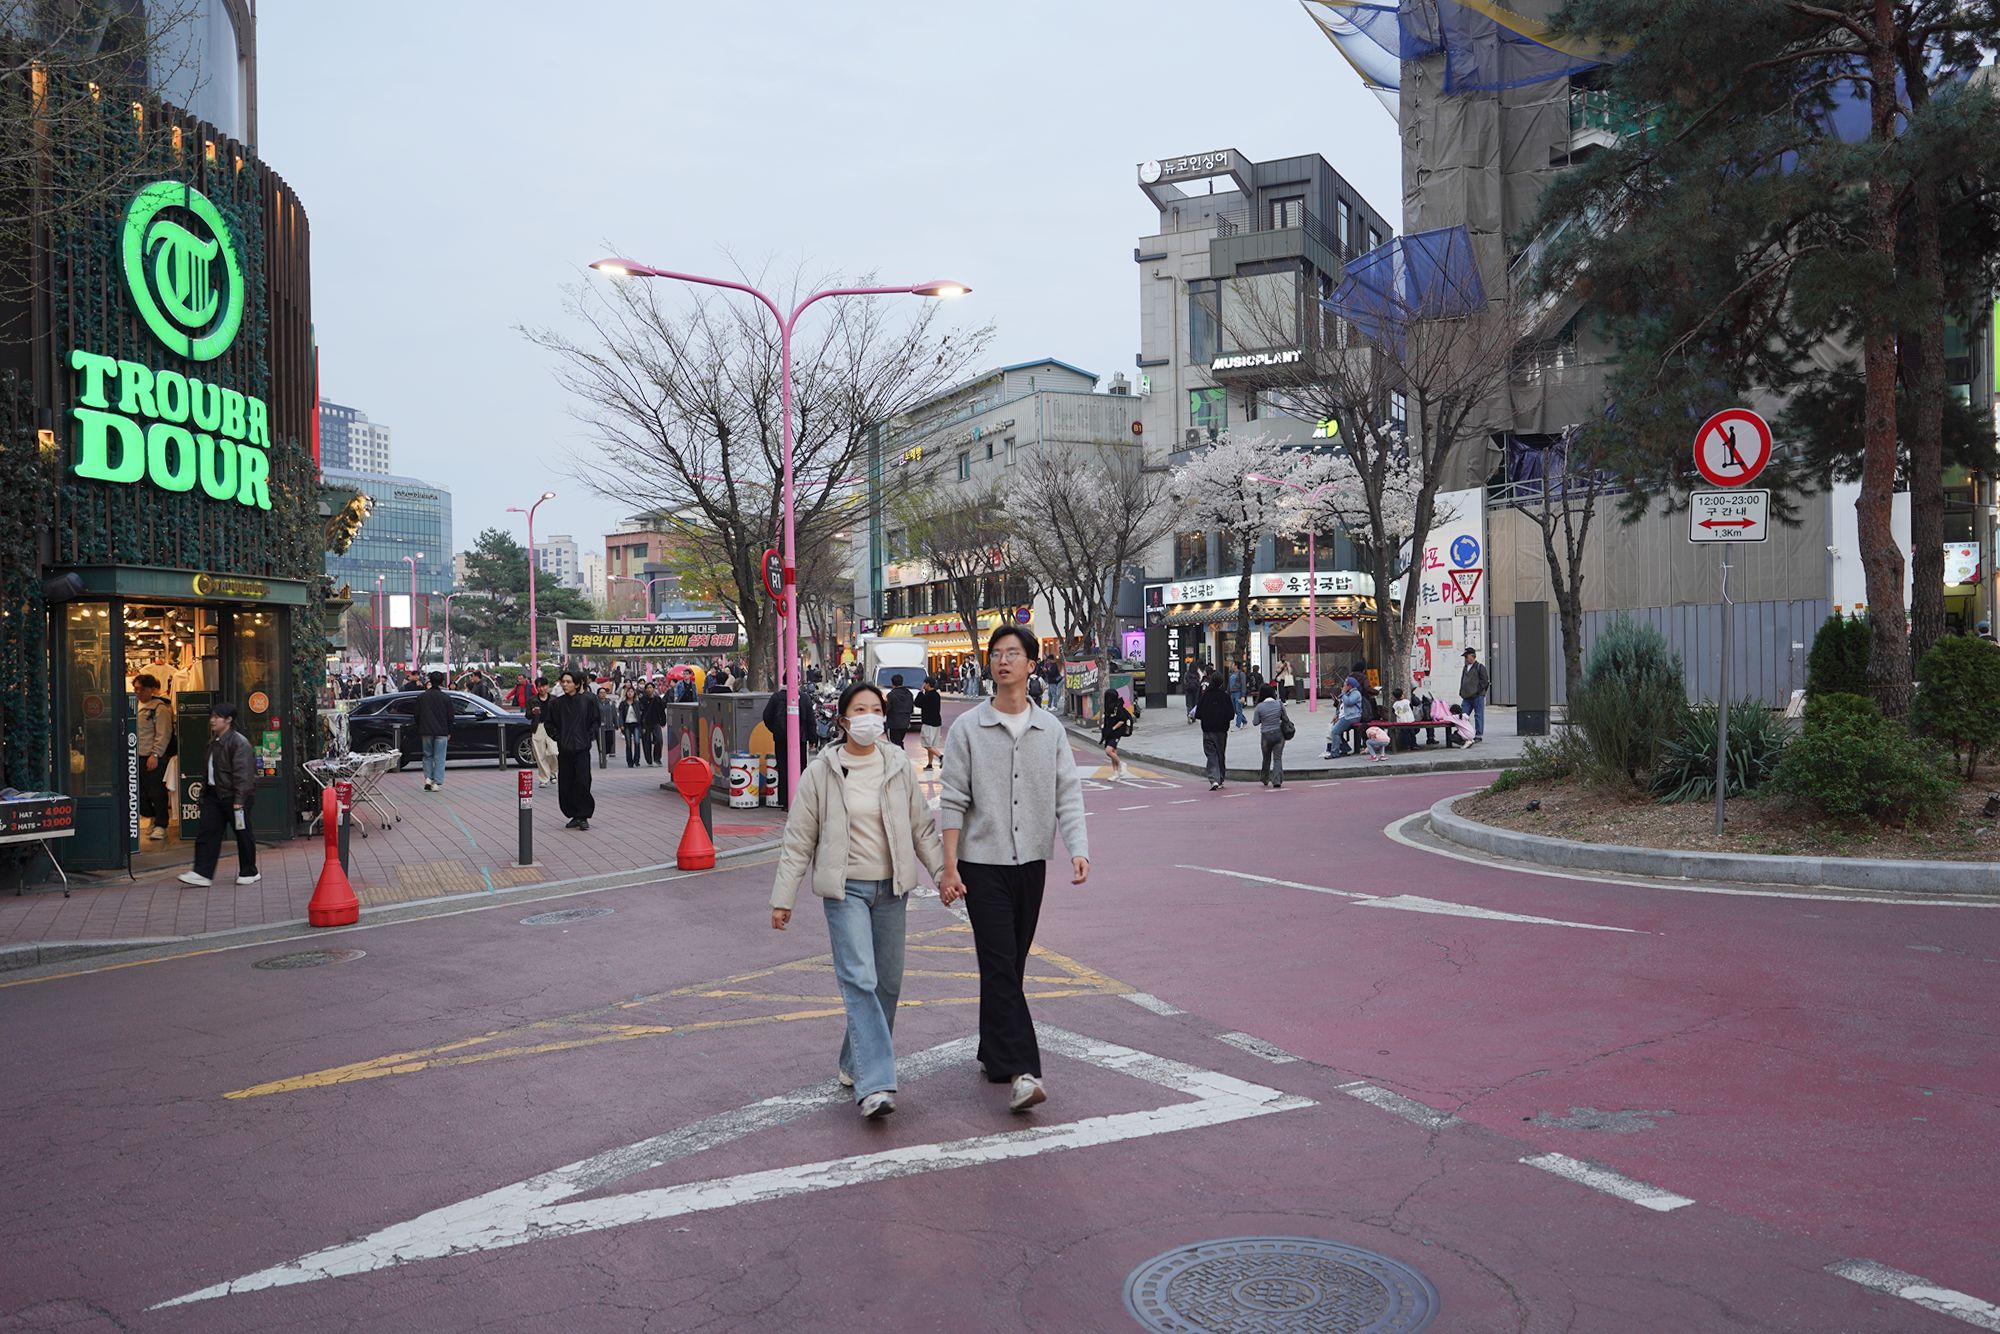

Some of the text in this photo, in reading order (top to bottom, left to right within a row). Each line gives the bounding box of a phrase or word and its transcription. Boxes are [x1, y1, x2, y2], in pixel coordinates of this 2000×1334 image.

[1164, 152, 1227, 175] 뉴코인싱어
[1211, 350, 1301, 370] MUSICPLANT
[71, 349, 271, 449] TROUBA
[1133, 424, 1141, 432] B1
[73, 407, 273, 511] DOUR
[1699, 495, 1760, 506] 12:00~23:00
[771, 572, 781, 589] R1
[1287, 576, 1351, 593] 육전국밥
[1181, 584, 1214, 600] 육전국밥
[1422, 582, 1440, 606] 좋은
[589, 624, 717, 634] 국토교통부는 처음 계획대로
[571, 635, 623, 647] 전철역사를
[624, 635, 645, 647] 홍대
[648, 635, 688, 647] 사거리에
[688, 634, 709, 646] 설치
[1167, 629, 1180, 682] 코인노래방
[128, 747, 138, 839] TROUBADOUR
[19, 811, 34, 819] HAT
[10, 823, 17, 831] 3
[17, 822, 36, 831] HATS
